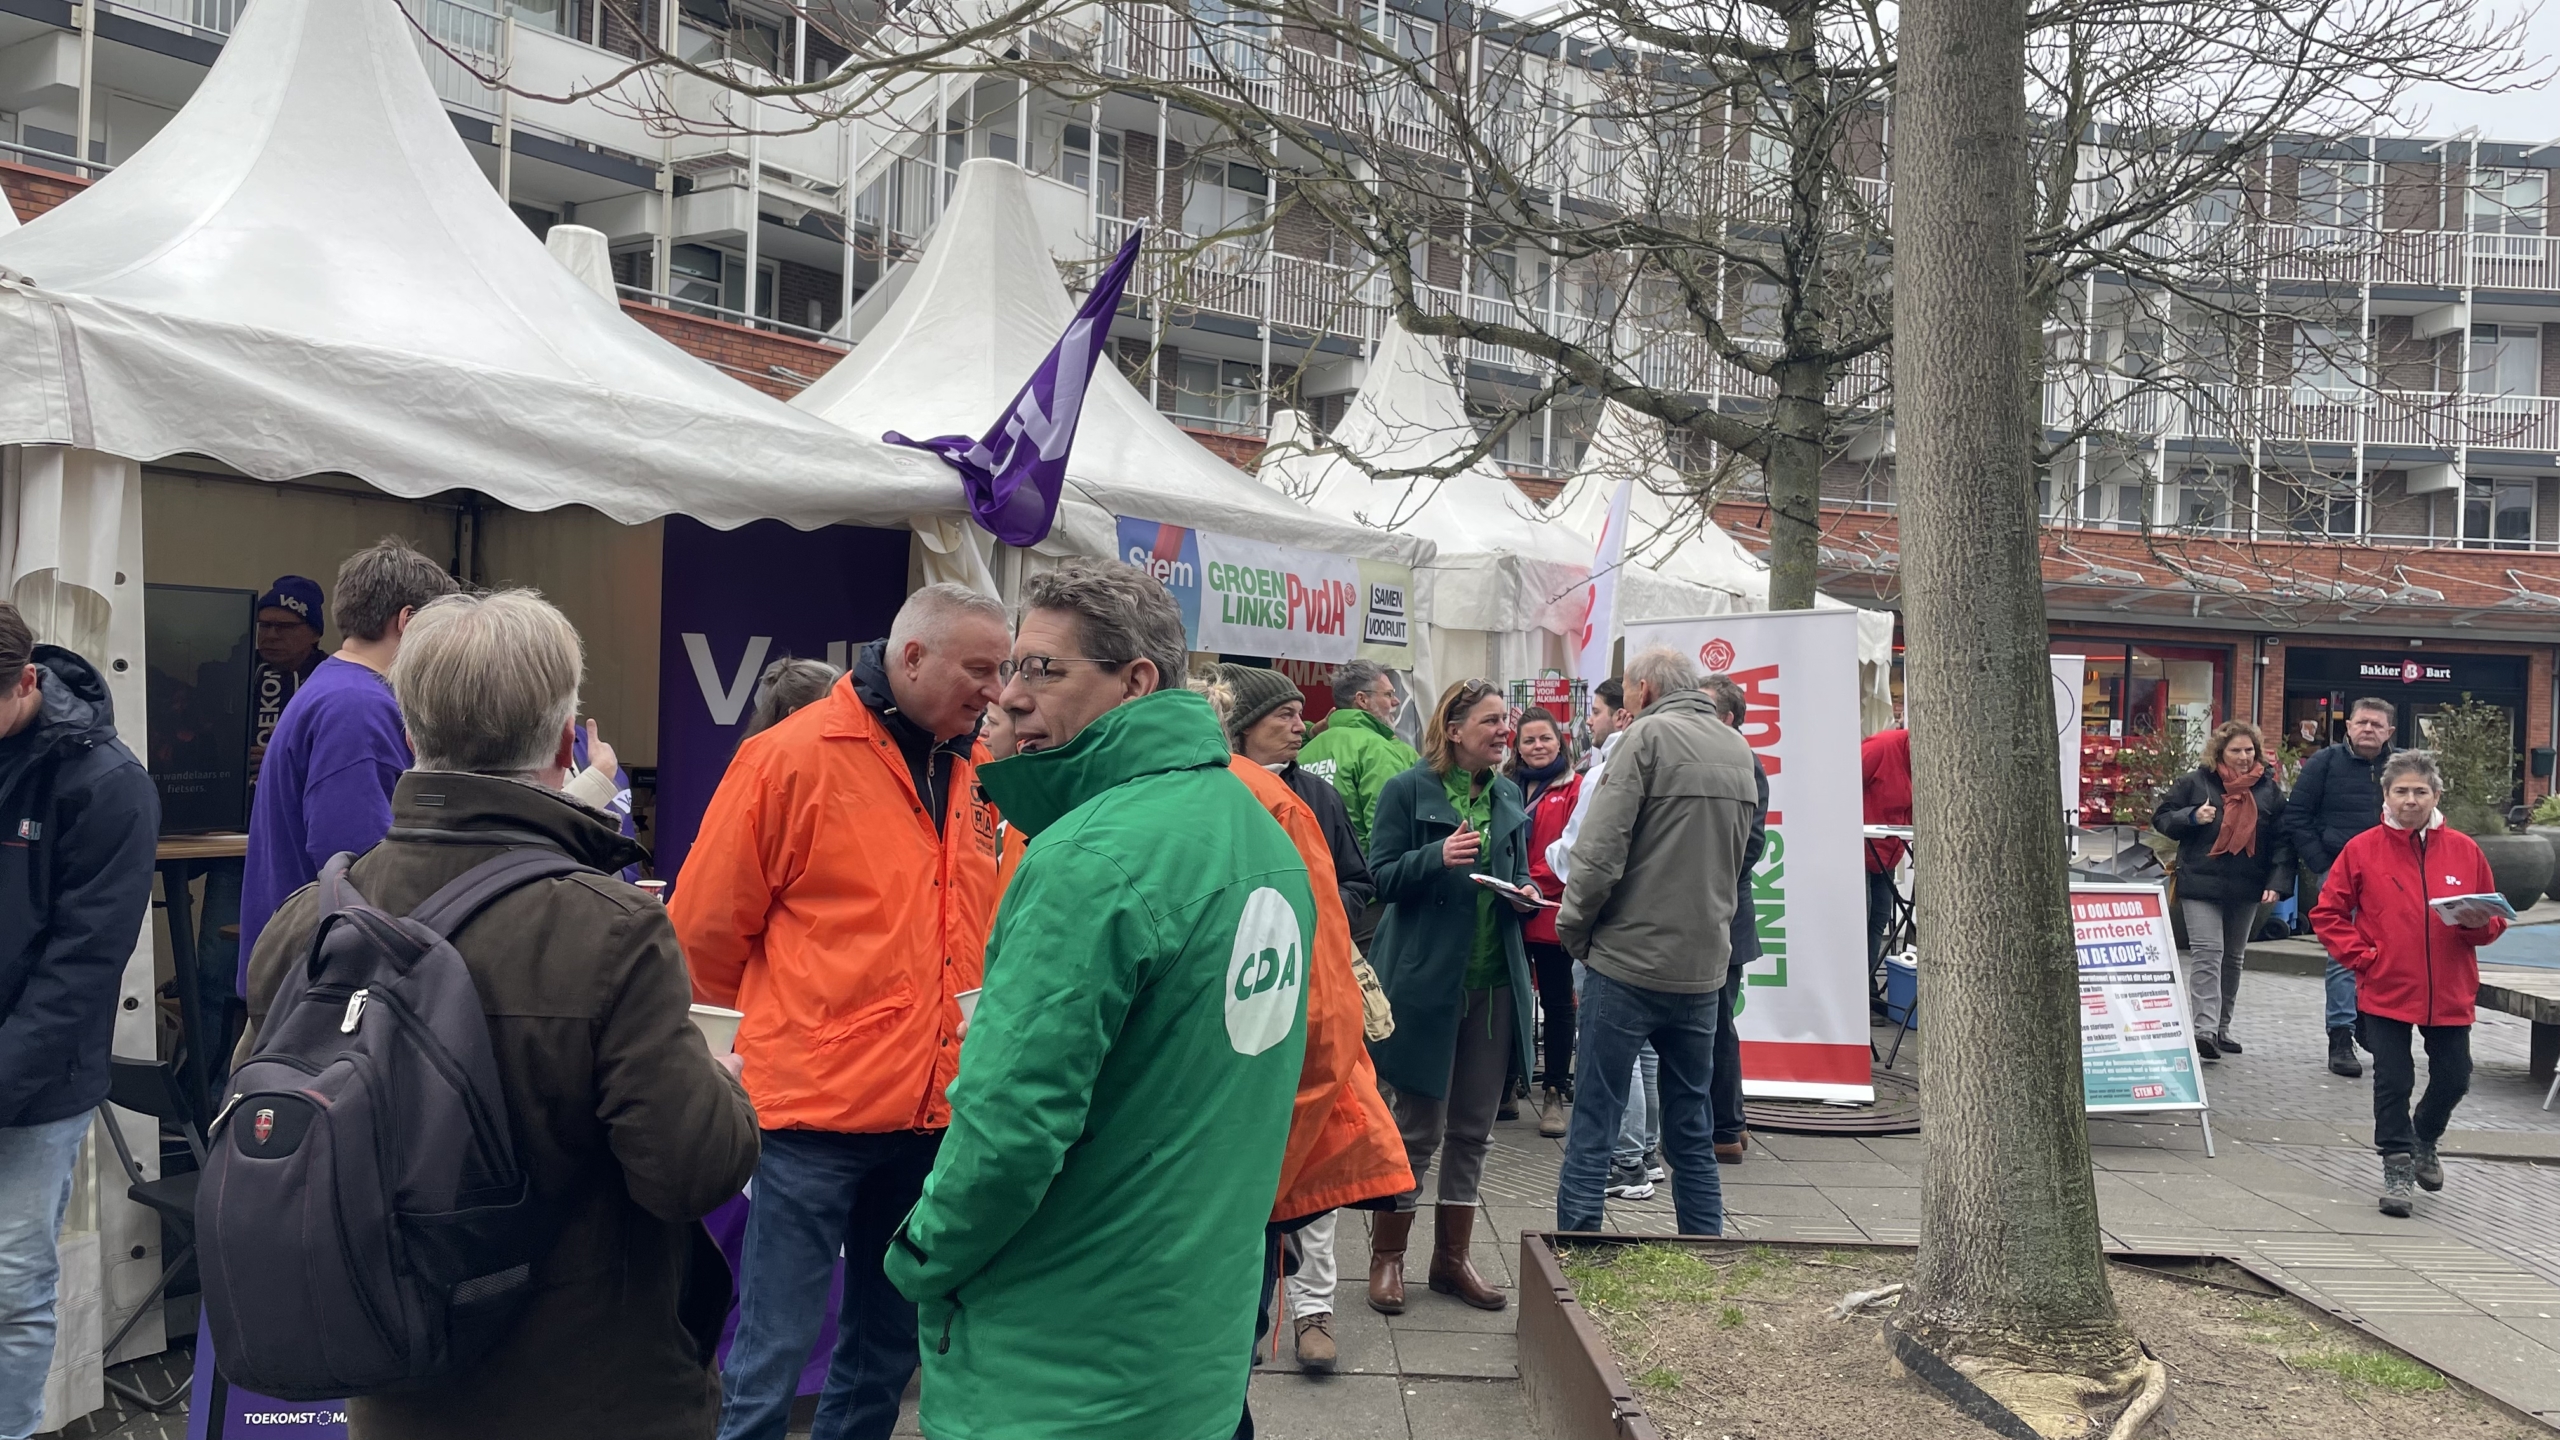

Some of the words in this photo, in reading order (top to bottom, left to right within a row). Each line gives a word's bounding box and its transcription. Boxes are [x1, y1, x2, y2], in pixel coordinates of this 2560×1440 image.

[1129, 546, 1193, 588] Stem
[1207, 561, 1287, 600] GROEN
[280, 594, 309, 617] Volt
[1284, 573, 1346, 637] PvdA
[1374, 587, 1402, 609] SAMEN
[1222, 594, 1287, 630] LINKS
[1369, 617, 1407, 639] VOORUIT
[2360, 664, 2400, 676] Bakker
[2426, 667, 2451, 679] Bart
[1536, 680, 1561, 688] SAMEN
[1536, 688, 1556, 696] VOOR
[1536, 695, 1569, 703] ALKMAAR
[163, 770, 217, 781] wandelaars
[1299, 759, 1337, 775] ROEN
[2077, 904, 2087, 920] U
[2087, 902, 2112, 919] OOK
[2111, 901, 2144, 918] DOOR
[2090, 947, 2109, 965] DE
[2109, 944, 2144, 963] KOU?
[1234, 941, 1296, 1001] CDA
[2134, 1086, 2153, 1098] STEM
[2153, 1085, 2163, 1096] SP
[244, 1412, 316, 1424] TOEKOMST
